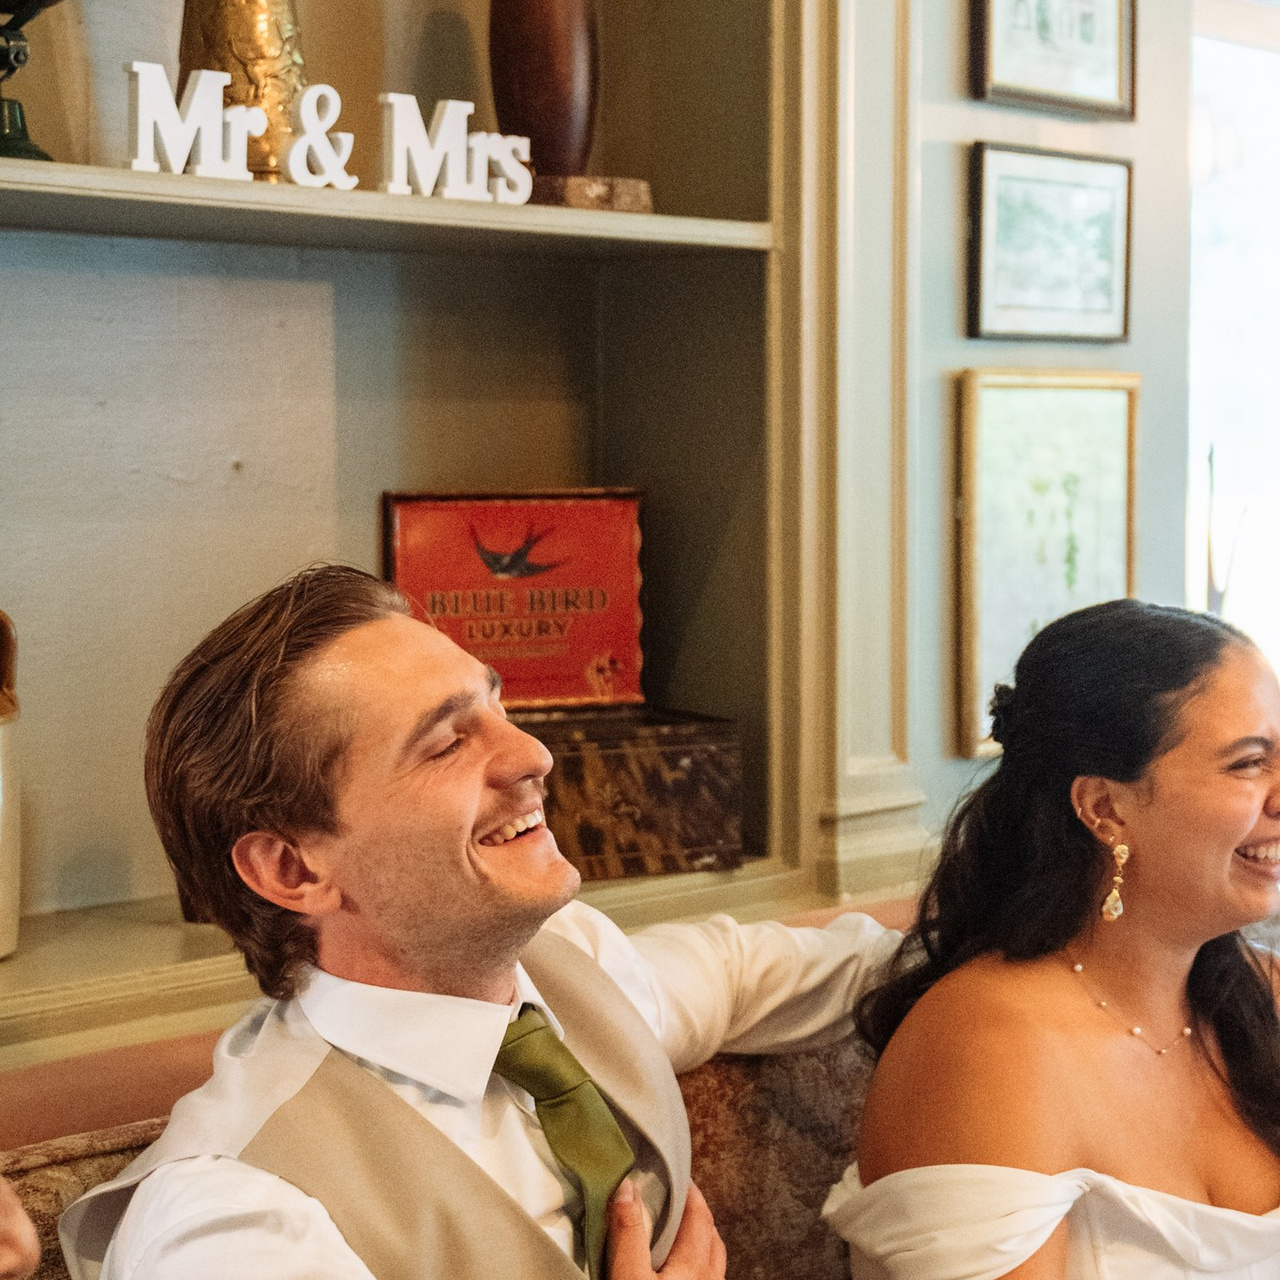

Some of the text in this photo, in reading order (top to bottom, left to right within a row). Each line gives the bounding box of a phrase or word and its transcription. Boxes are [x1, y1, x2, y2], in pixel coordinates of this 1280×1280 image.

[130, 61, 534, 206] Mr & Mrs
[526, 588, 608, 613] BIRD
[466, 619, 570, 640] LUXURY
